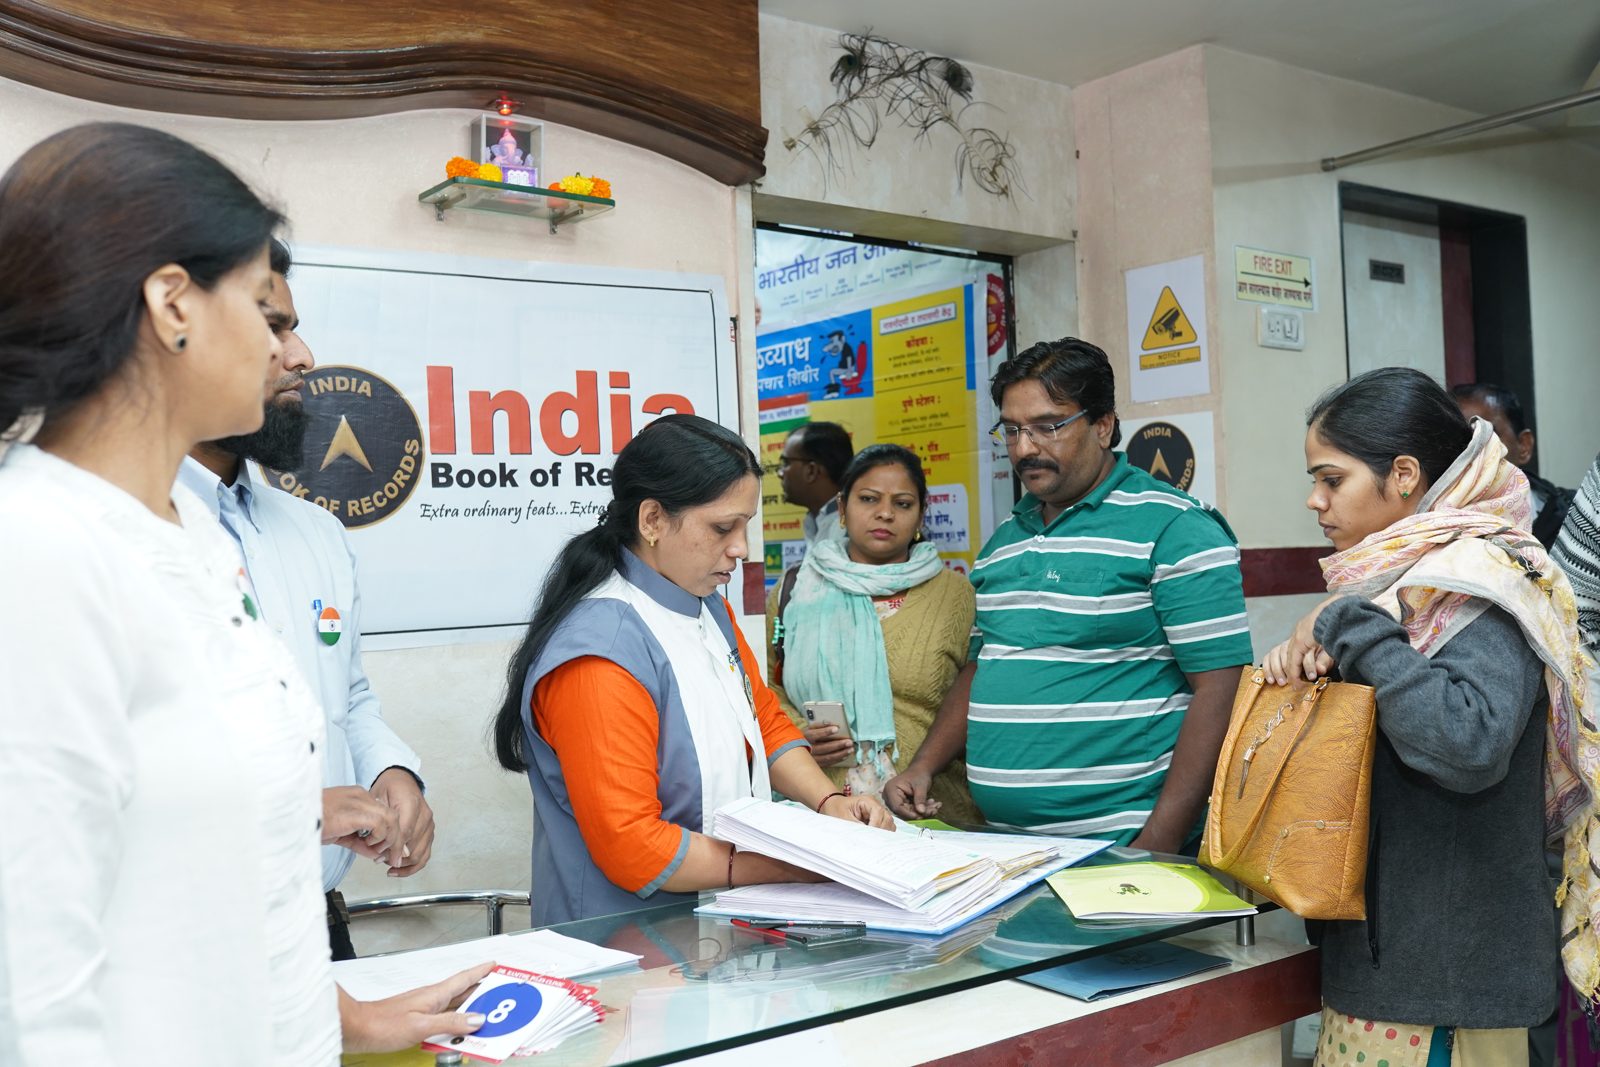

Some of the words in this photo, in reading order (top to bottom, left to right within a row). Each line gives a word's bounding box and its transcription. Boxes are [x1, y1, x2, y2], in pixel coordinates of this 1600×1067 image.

[758, 255, 820, 290] भारतीय
[825, 246, 857, 271] जन
[1254, 255, 1273, 273] FIRE
[1275, 258, 1292, 275] EXIT
[309, 376, 372, 398] INDIA
[1143, 426, 1172, 439] INDIA
[314, 496, 341, 513] OF
[347, 439, 420, 517] RECORDS
[430, 462, 519, 488] Book
[530, 462, 562, 487] of
[575, 462, 614, 487] Re
[420, 503, 459, 521] Extra
[464, 500, 522, 524] ordinary
[487, 998, 516, 1024] 8
